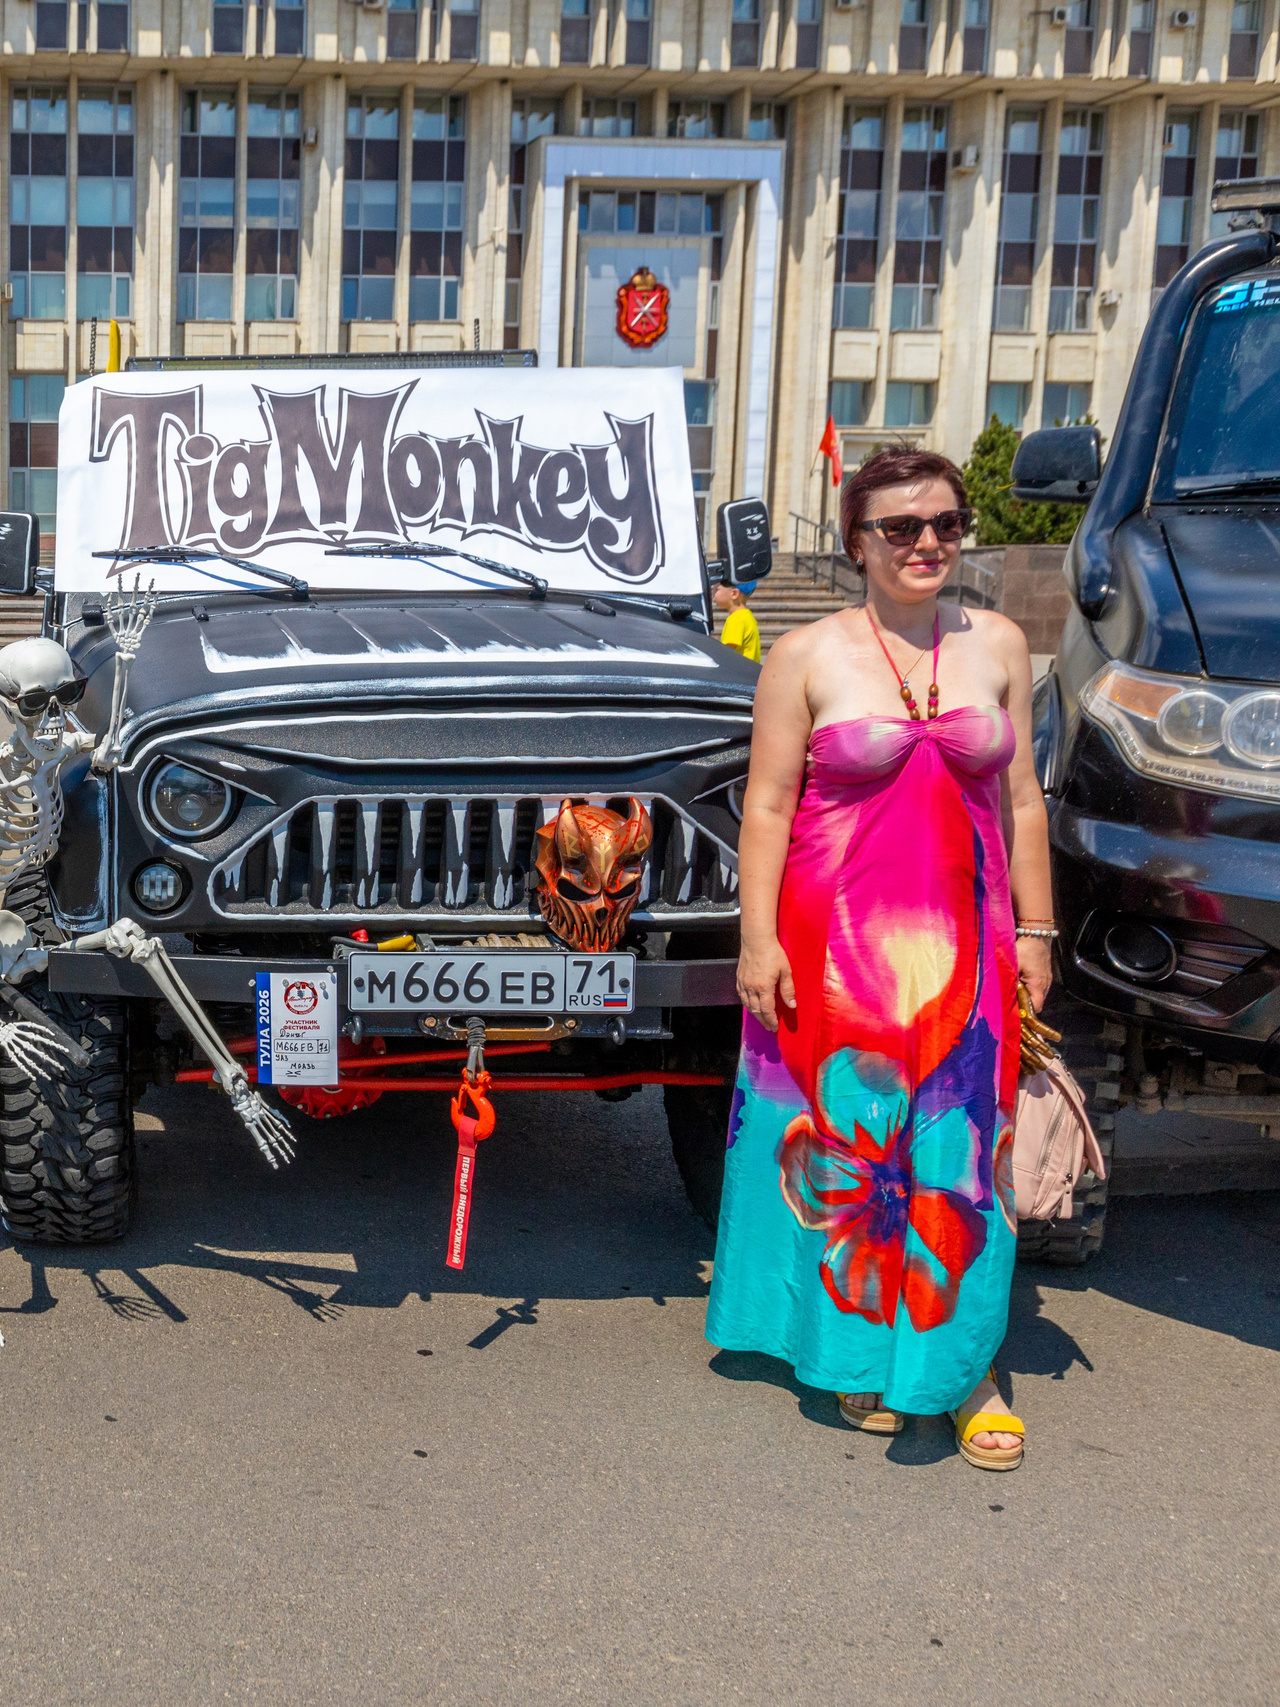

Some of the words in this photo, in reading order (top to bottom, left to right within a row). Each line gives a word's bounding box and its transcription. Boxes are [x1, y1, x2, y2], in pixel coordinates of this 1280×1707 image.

[1213, 301, 1249, 313] JEEP
[572, 959, 616, 994] 71
[258, 989, 270, 1025] 2026
[569, 994, 603, 1007] RUS
[259, 1027, 271, 1068] ТУЛА
[275, 1054, 289, 1062] УАЗ
[290, 1062, 316, 1070] МРАЗЬ
[459, 1156, 470, 1193] ПЕРВЫЙ
[451, 1194, 467, 1265] ВНЕДОРОЖНЫЙ
